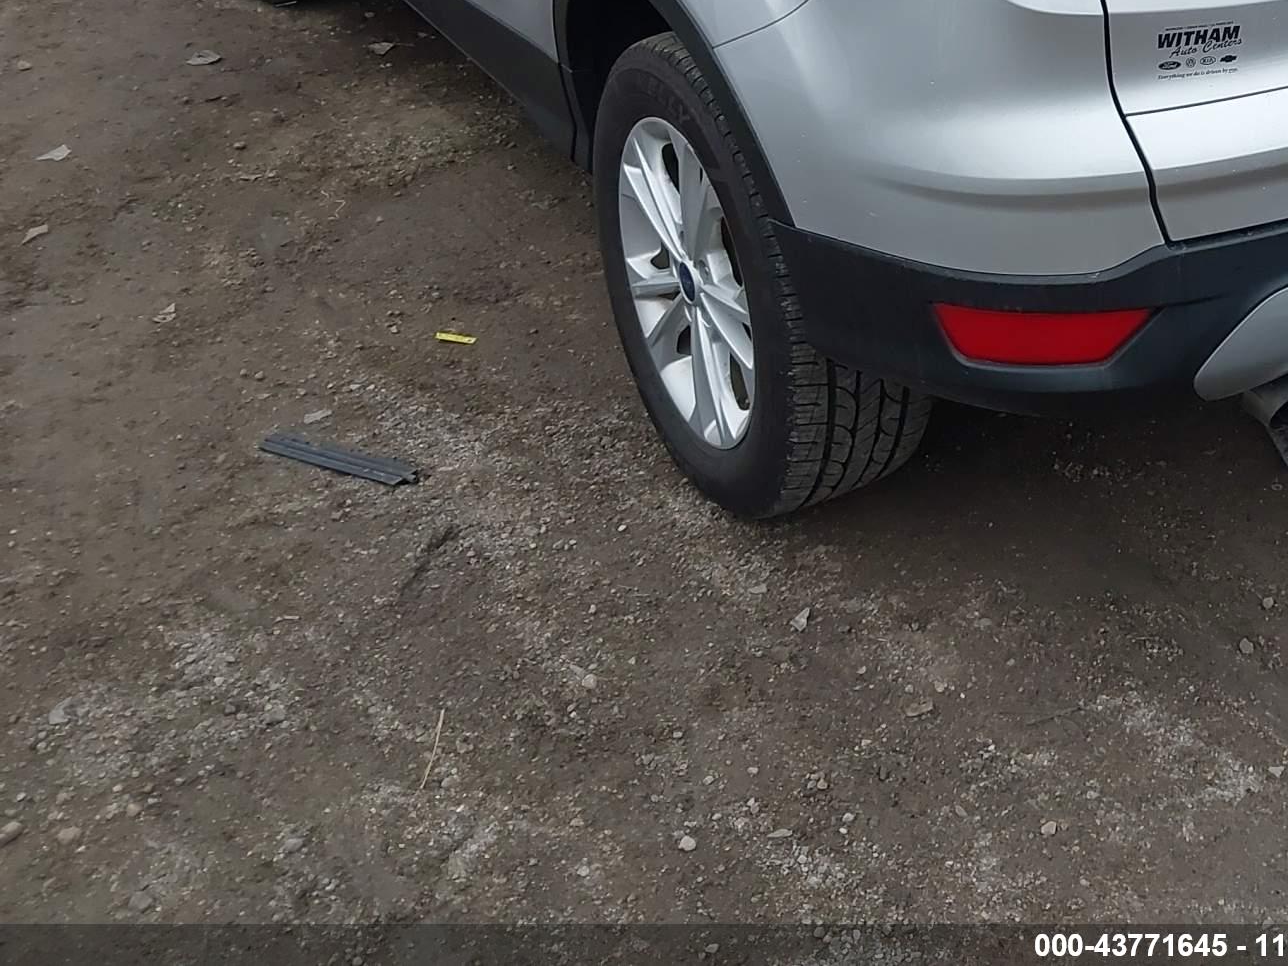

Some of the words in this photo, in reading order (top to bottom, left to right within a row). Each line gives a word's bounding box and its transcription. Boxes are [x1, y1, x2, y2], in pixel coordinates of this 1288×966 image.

[1158, 25, 1241, 49] WITHAM
[1169, 45, 1198, 59] Auto
[1202, 38, 1242, 53] Centers
